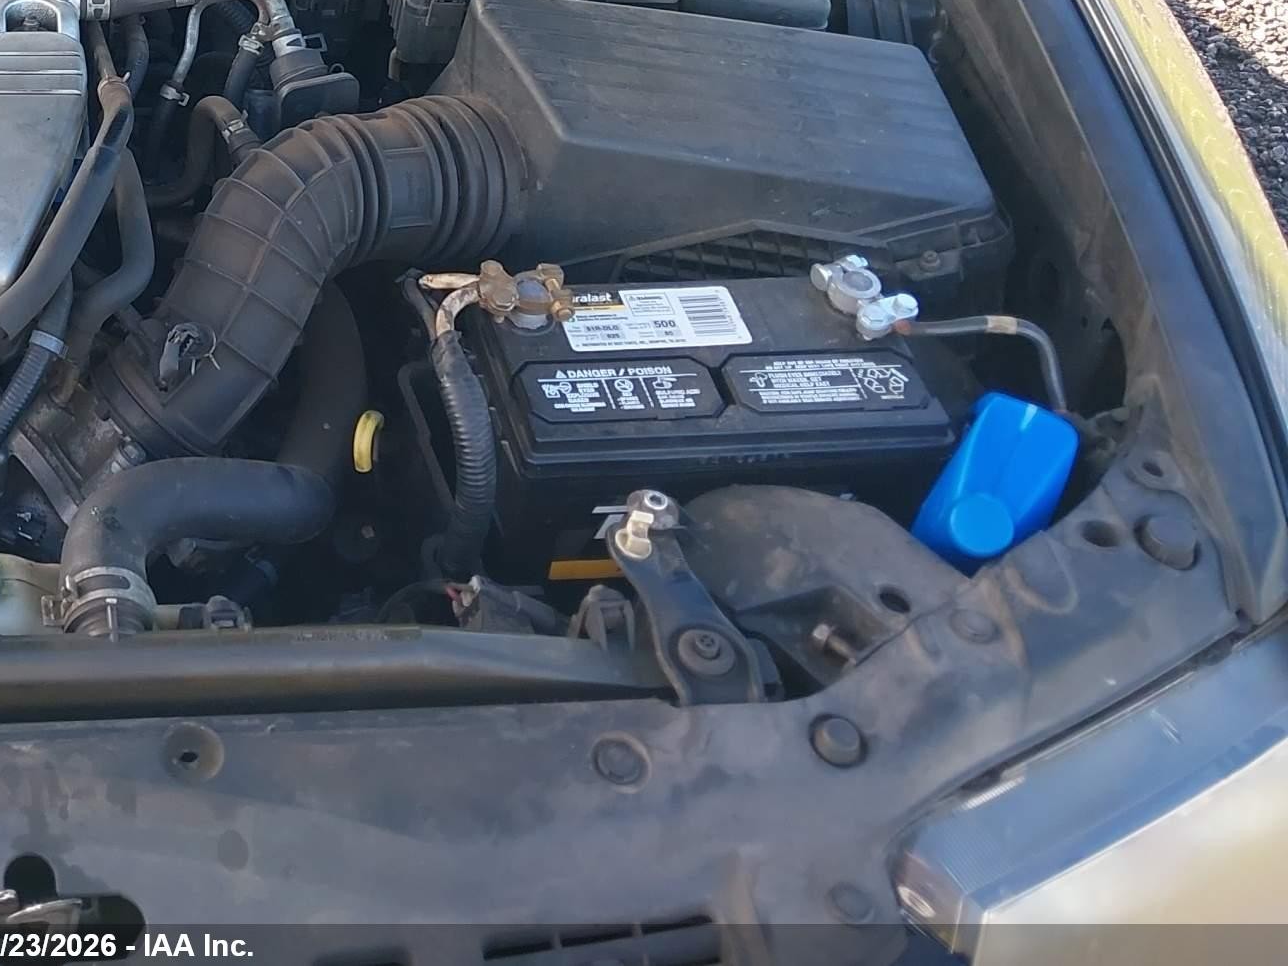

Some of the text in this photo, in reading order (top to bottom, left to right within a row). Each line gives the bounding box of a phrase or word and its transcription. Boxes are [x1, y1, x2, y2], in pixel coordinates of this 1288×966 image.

[653, 320, 677, 329] 500
[566, 369, 617, 379] DANGER
[628, 366, 673, 376] POISON
